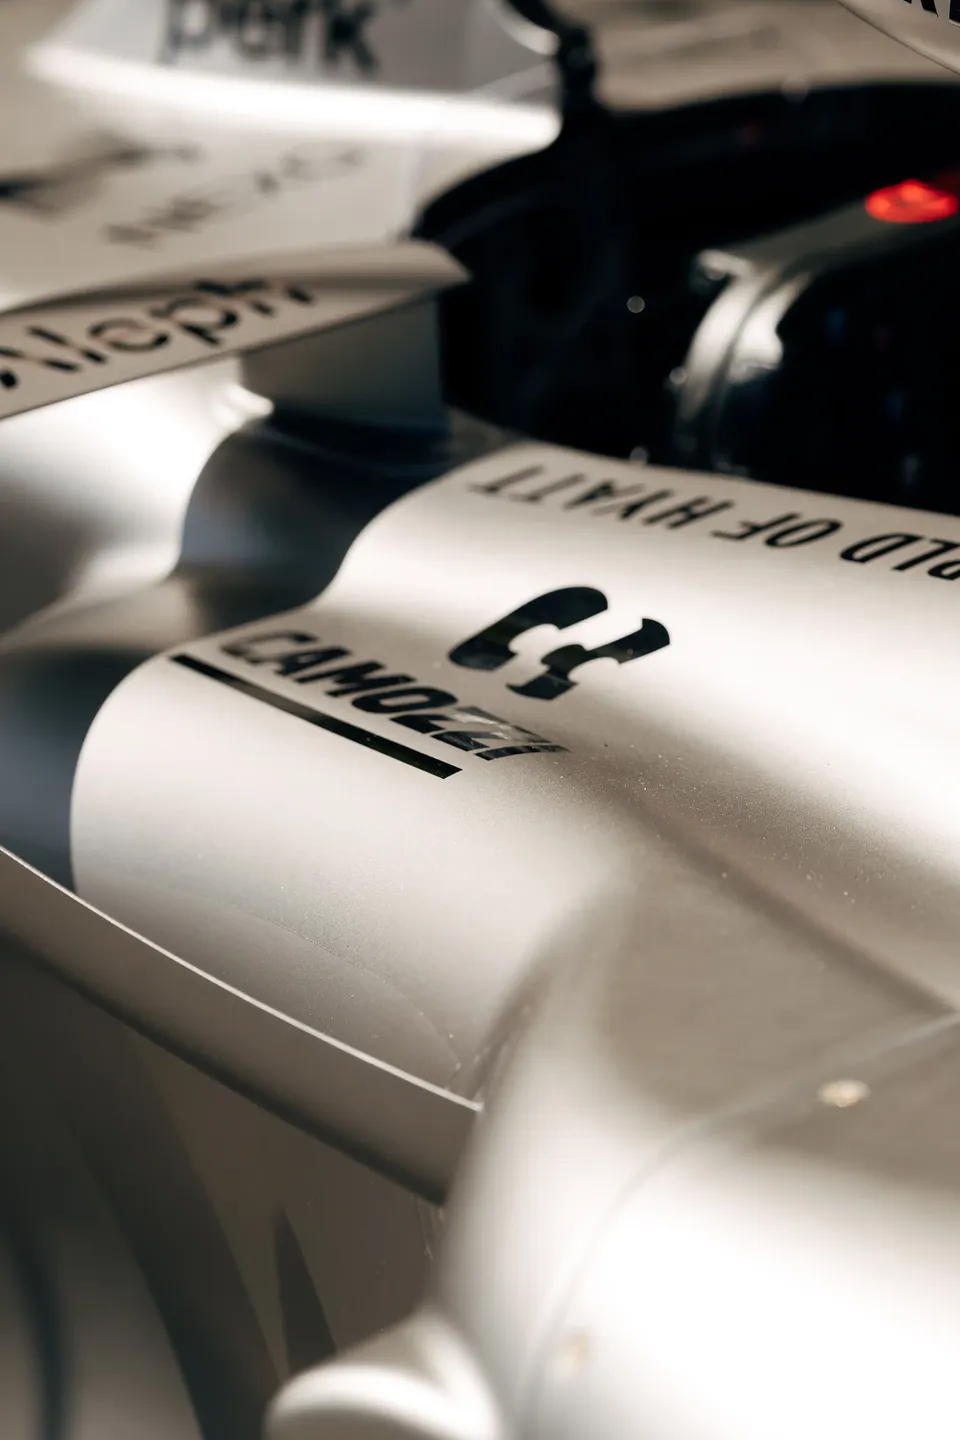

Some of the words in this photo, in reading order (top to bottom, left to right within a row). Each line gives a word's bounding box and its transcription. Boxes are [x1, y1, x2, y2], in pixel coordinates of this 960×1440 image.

[471, 465, 735, 527] HYATT
[711, 511, 843, 549] OF
[220, 629, 571, 761] CAMOZZI
